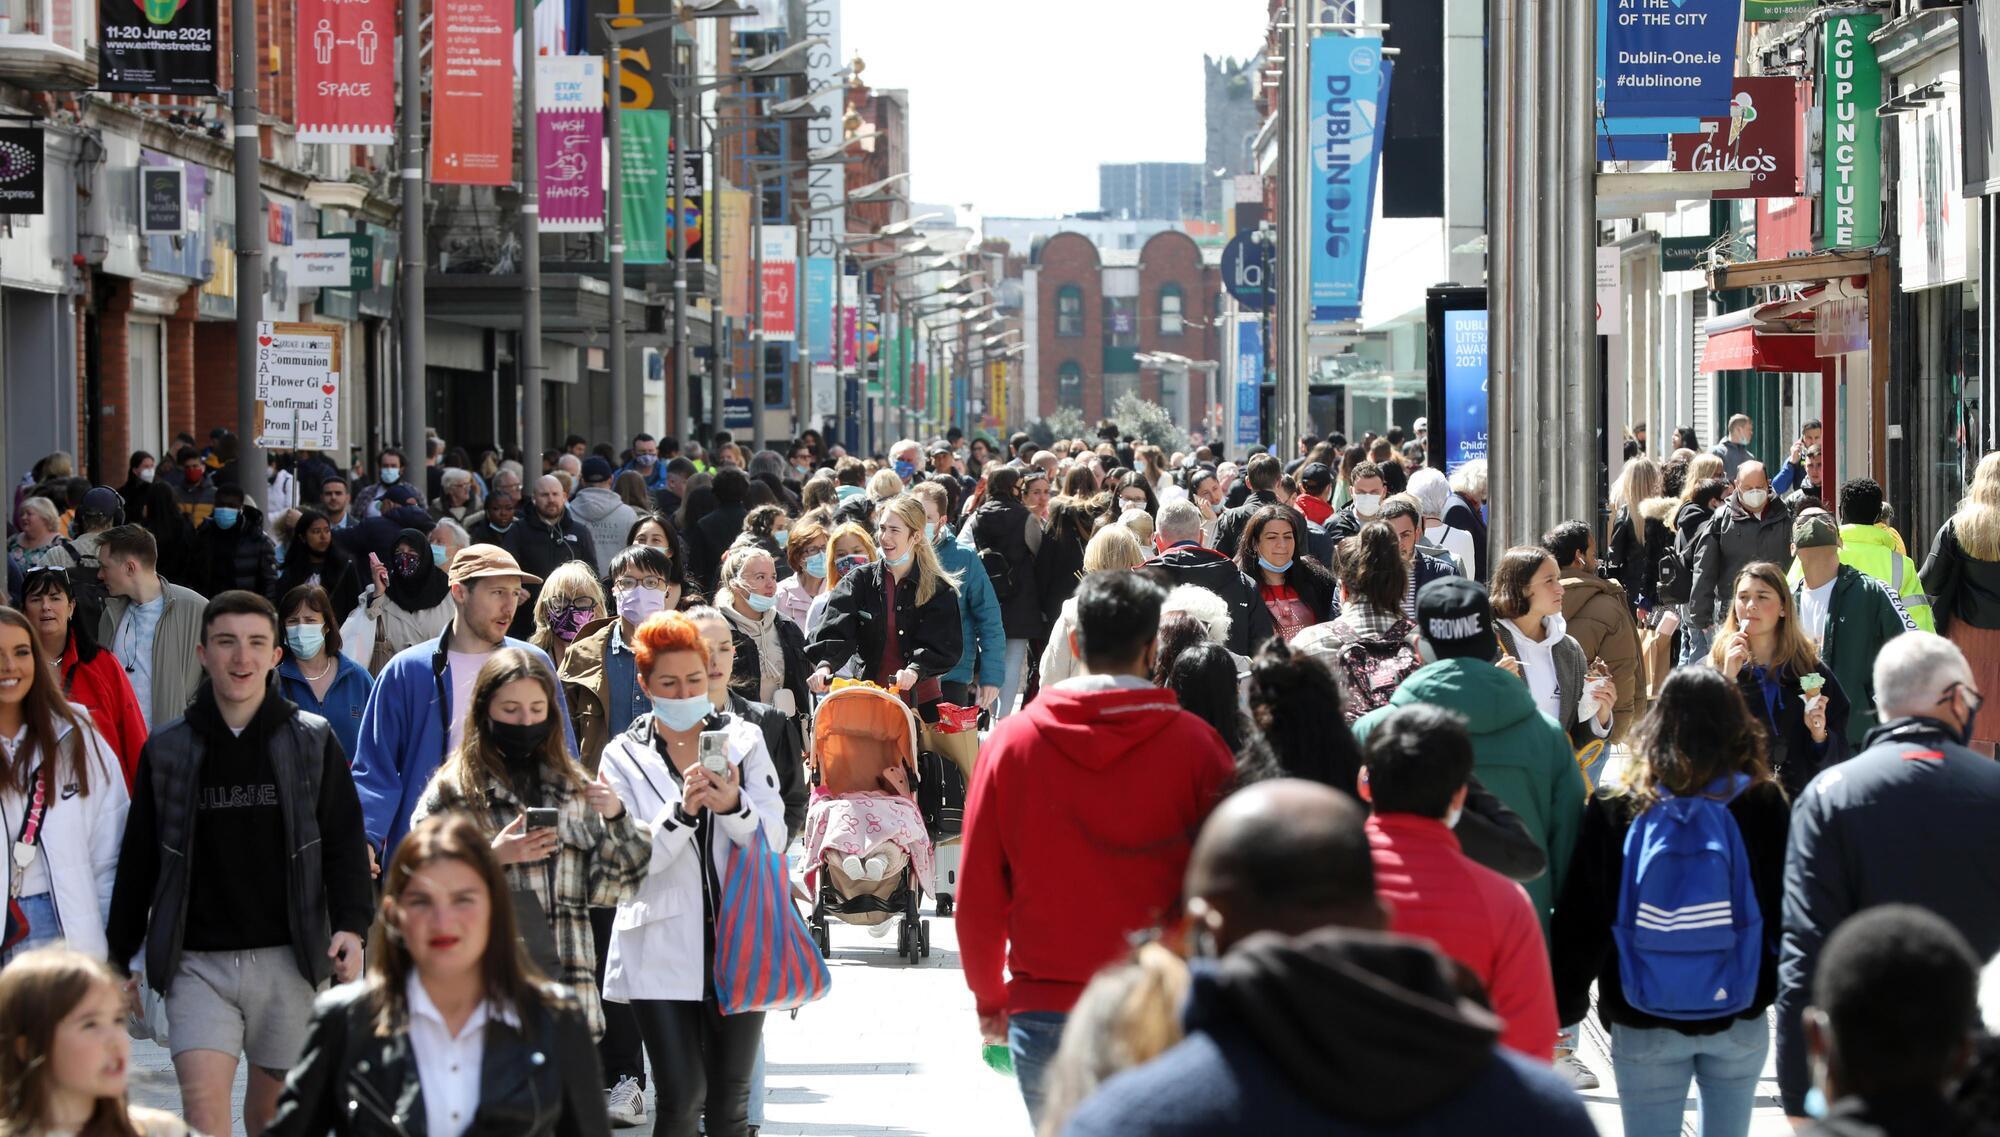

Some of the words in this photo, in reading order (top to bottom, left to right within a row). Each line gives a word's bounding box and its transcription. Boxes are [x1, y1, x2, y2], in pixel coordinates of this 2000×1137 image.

[1642, 0, 1669, 8] THE
[1618, 14, 1638, 25] OF
[1642, 14, 1670, 25] THE
[1674, 14, 1707, 25] CITY
[106, 26, 142, 38] 11-20
[143, 27, 178, 39] June
[179, 28, 211, 40] 2021
[106, 41, 212, 51] www.eatthestreets.ie
[1619, 51, 1721, 64] Dublin-One.ie
[554, 82, 582, 90] STAY
[1617, 74, 1702, 86] #dublinone
[317, 81, 372, 96] SPACE
[555, 92, 582, 101] SAFE
[551, 120, 585, 132] WASH
[1834, 18, 1856, 246] ACUPUNCTURE
[1691, 142, 1777, 172] Gino's
[154, 192, 172, 200] the
[546, 186, 590, 198] HANDS
[151, 213, 176, 222] store
[1456, 332, 1488, 343] LITER
[1456, 344, 1488, 355] AWAR
[271, 354, 329, 366] Communion
[1456, 356, 1482, 367] 2021
[258, 348, 270, 399] SALE
[270, 375, 304, 388] Flower
[264, 418, 290, 430] Prom
[321, 397, 333, 447] SALE
